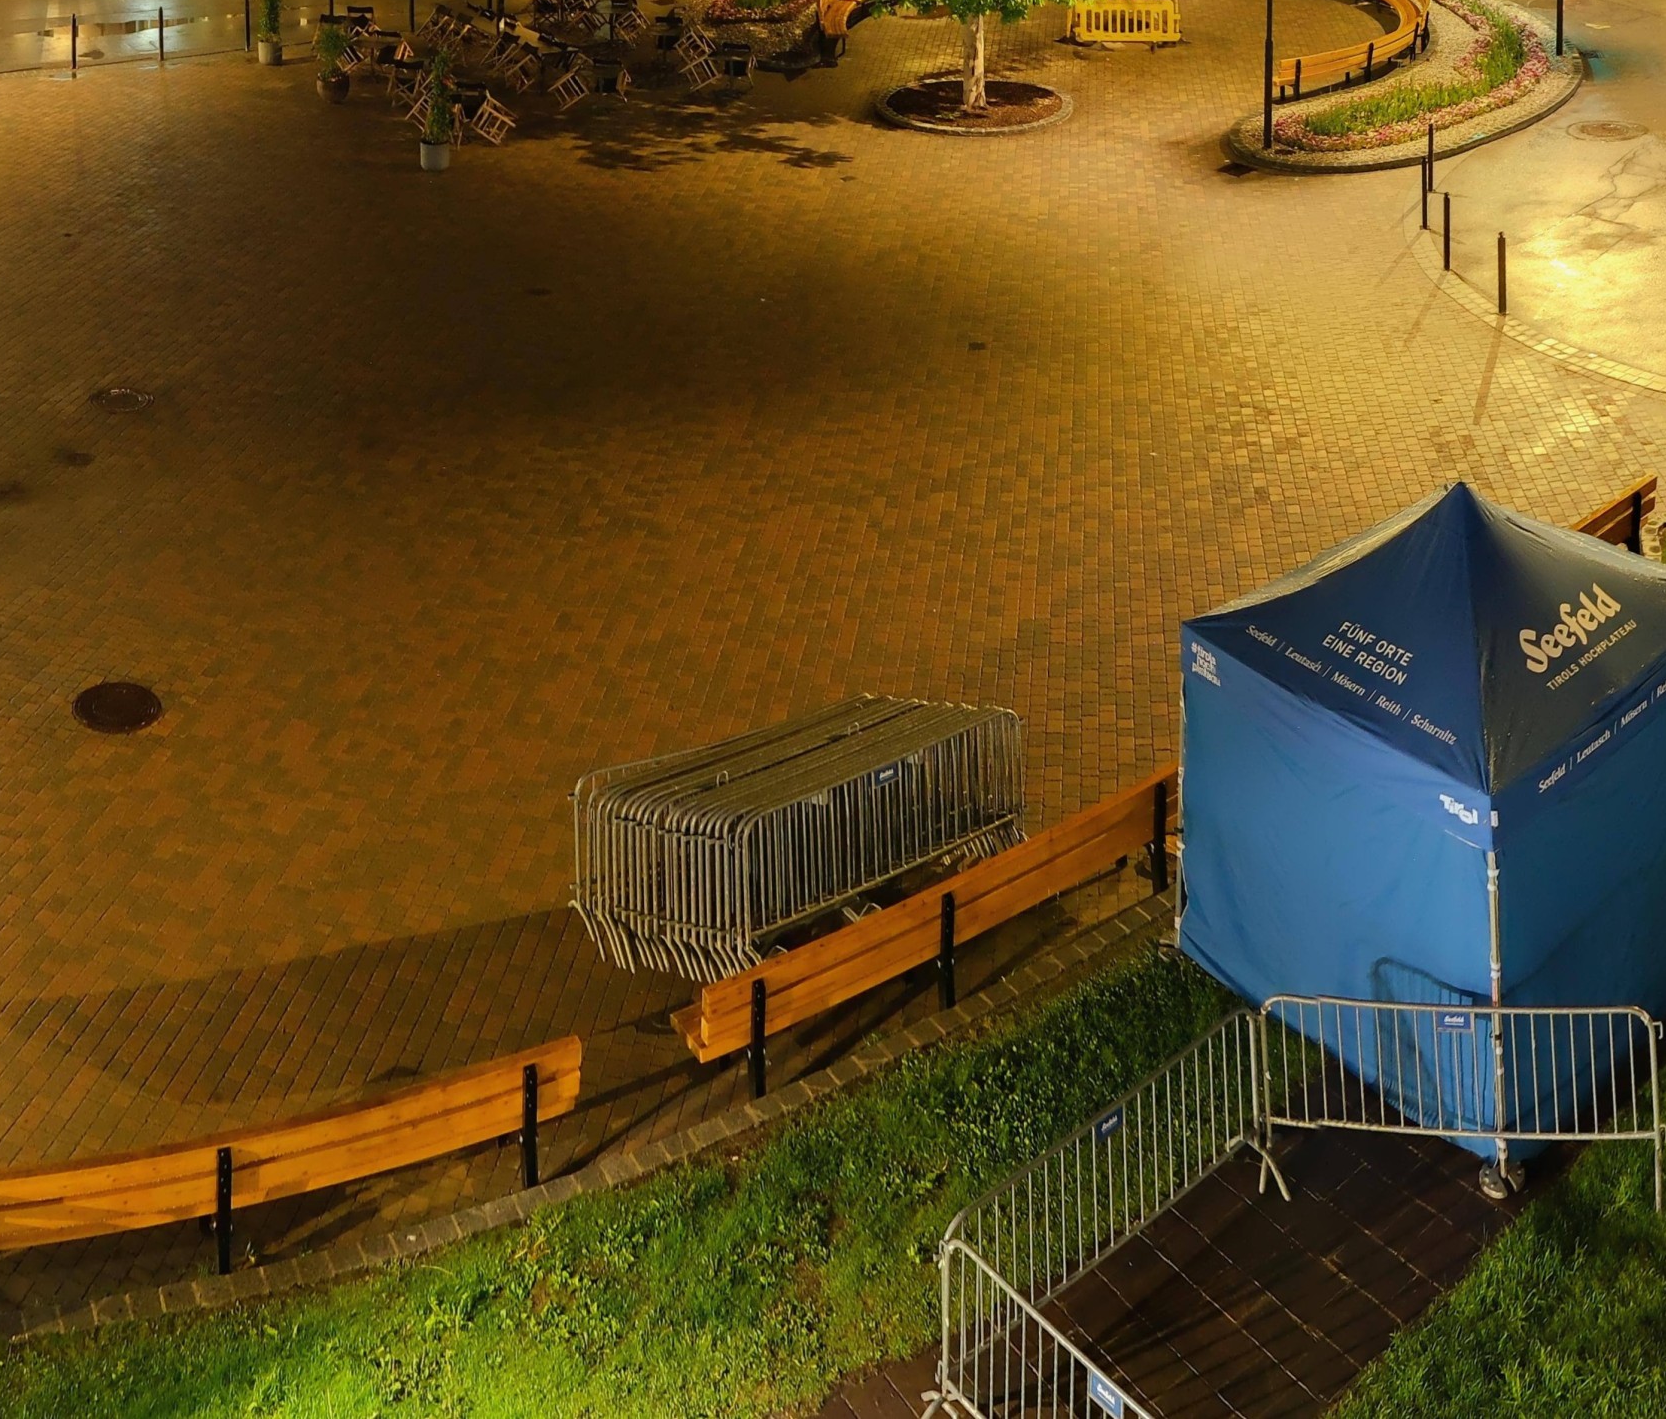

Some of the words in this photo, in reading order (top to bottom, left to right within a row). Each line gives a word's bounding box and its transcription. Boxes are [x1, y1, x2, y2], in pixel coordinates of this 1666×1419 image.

[1322, 634, 1356, 659] EINE
[1357, 651, 1409, 686] REGION
[1339, 621, 1376, 647] FÜNF
[1375, 636, 1413, 667] ORTE
[1519, 582, 1622, 673] Seefeld
[1546, 663, 1579, 691] TIROLS
[1579, 619, 1637, 667] HOCHPLATEAU
[1245, 625, 1277, 647] Seefeld
[1285, 647, 1322, 672] Leutasch
[1331, 670, 1366, 697] Mösern
[1375, 693, 1402, 717] Reith
[1411, 714, 1457, 745] Scharnitz
[1539, 763, 1566, 793] Seefeld
[1576, 729, 1611, 765] Leutasch
[1621, 699, 1647, 729] Mösern
[1439, 793, 1479, 825] Tirol
